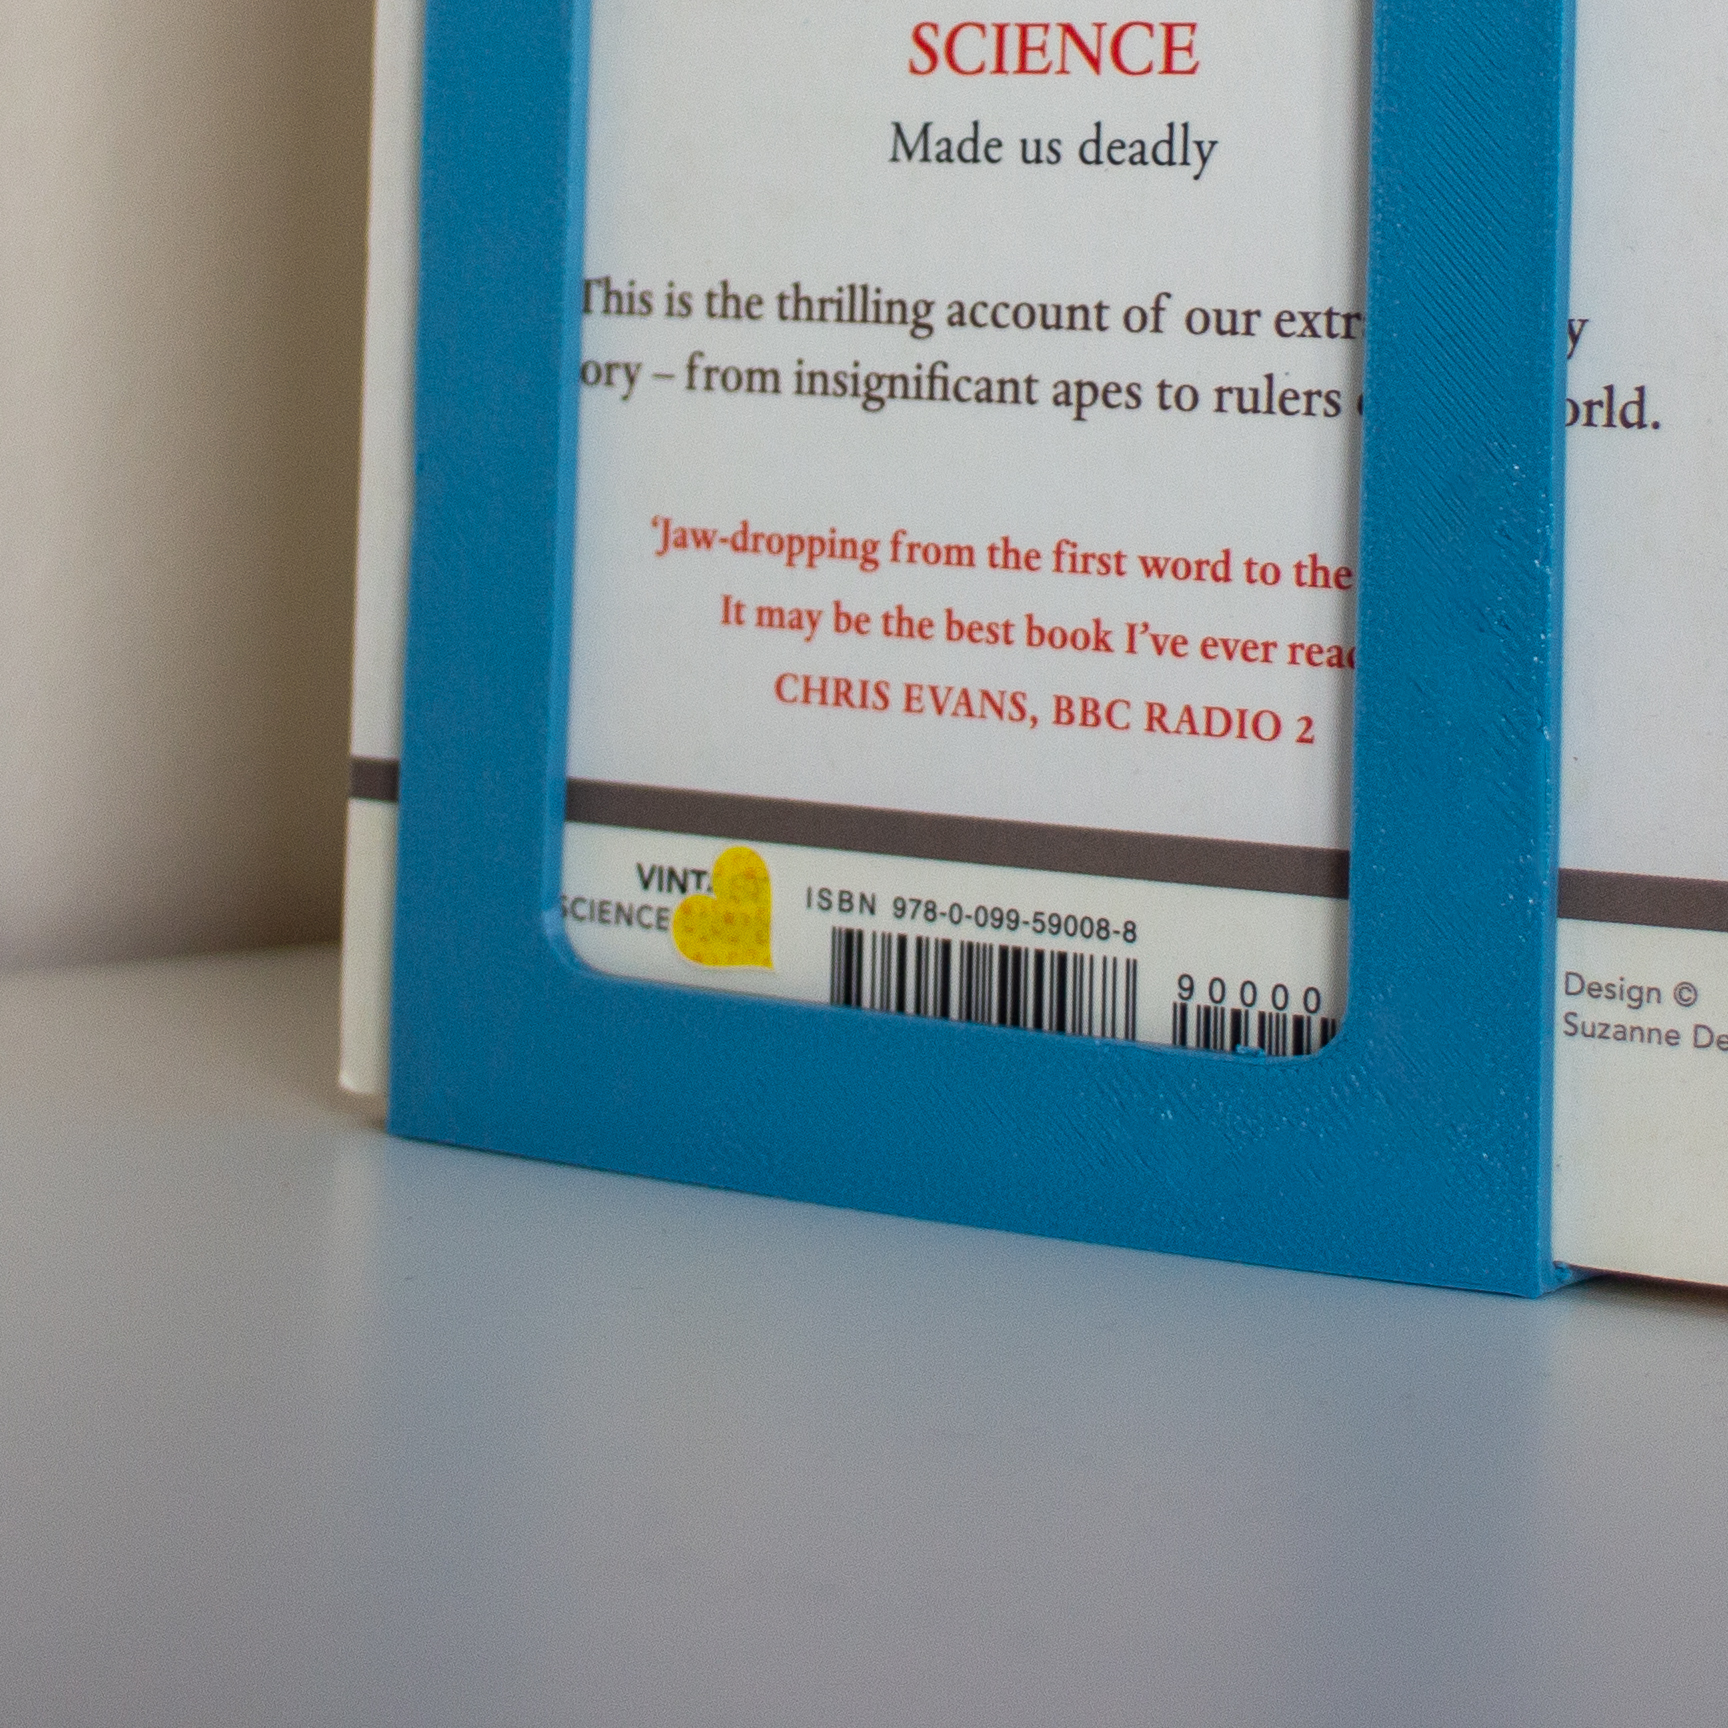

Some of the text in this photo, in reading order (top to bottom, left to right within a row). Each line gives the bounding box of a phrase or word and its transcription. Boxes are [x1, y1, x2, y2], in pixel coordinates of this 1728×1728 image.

[909, 21, 1199, 76] SCIENCE
[890, 120, 1218, 181] Made us deadly
[582, 276, 653, 317] This
[665, 281, 693, 319] is
[705, 279, 764, 321] the
[776, 281, 935, 340] thrilling
[947, 300, 1110, 332] account
[1123, 292, 1172, 333] of
[1185, 307, 1262, 336] our
[686, 351, 781, 395] from
[794, 358, 1039, 413] insignificant
[1052, 380, 1142, 422] apes
[1157, 379, 1199, 412] to
[1214, 373, 1342, 418] rulers
[890, 529, 976, 568] from
[987, 536, 1041, 572] the
[1053, 539, 1127, 577] first
[1138, 548, 1232, 583] word
[1244, 558, 1281, 586] to
[1293, 552, 1354, 590] the
[721, 594, 745, 626] It
[755, 606, 823, 643] may
[833, 600, 871, 636] be
[882, 604, 935, 641] the
[945, 608, 1015, 646] best
[1025, 613, 1114, 653] book
[1200, 637, 1278, 664] ever
[774, 673, 1315, 745] CHRIS EVANS, BBC RADIO 2
[806, 887, 1137, 944] ISBN 978-0-099-59008-8
[1564, 971, 1662, 1010] Design
[1563, 1011, 1681, 1047] Suzanne
